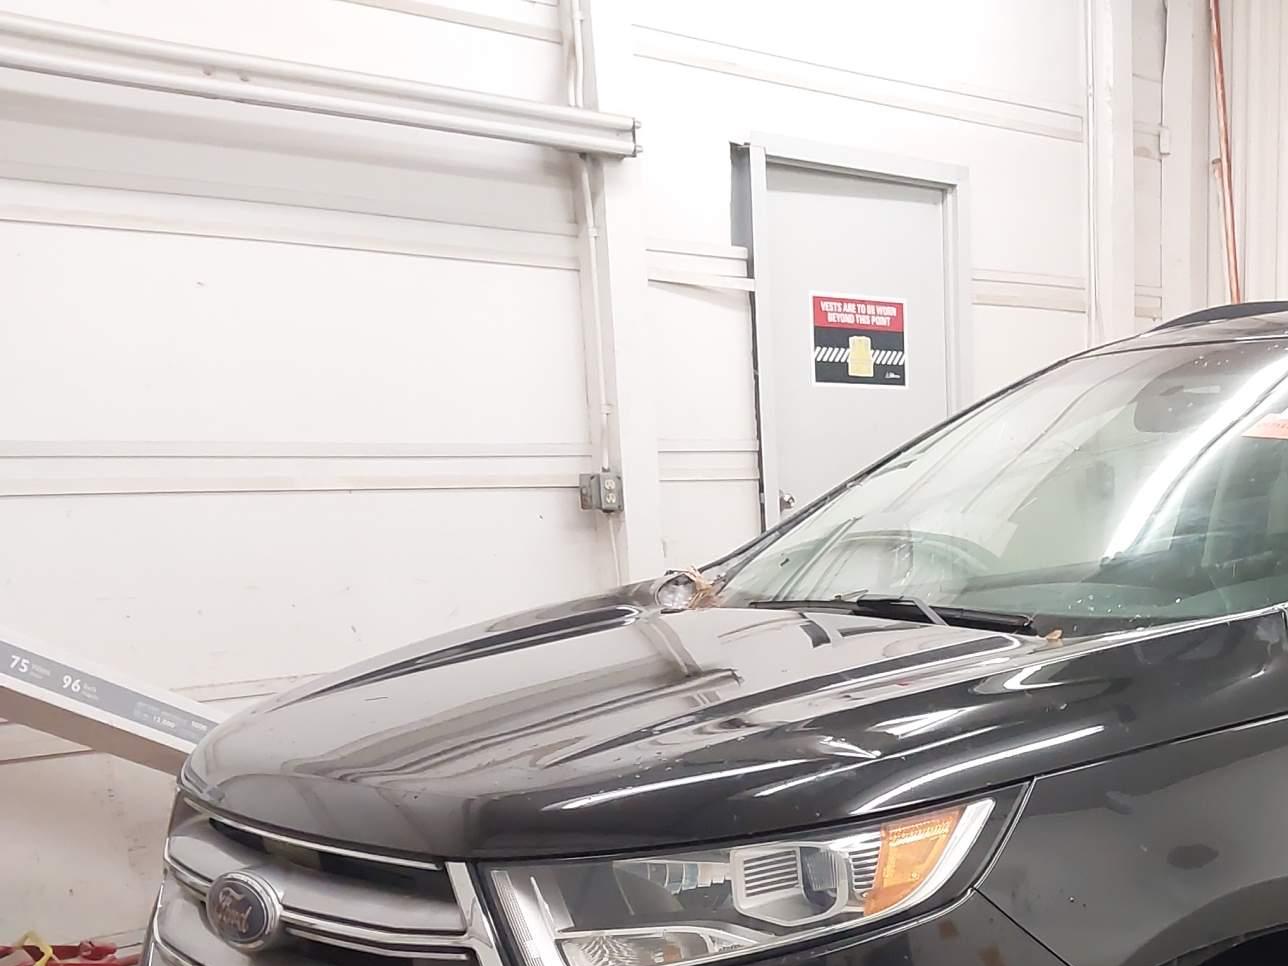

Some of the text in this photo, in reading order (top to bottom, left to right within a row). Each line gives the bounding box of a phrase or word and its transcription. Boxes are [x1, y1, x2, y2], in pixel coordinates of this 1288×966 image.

[821, 301, 842, 312] VESTS
[843, 303, 856, 313] ARE
[857, 304, 866, 314] TO
[876, 306, 897, 316] WORN
[828, 313, 891, 326] BEYOND THIS POINT
[9, 655, 31, 673] 75
[62, 675, 81, 693] 96
